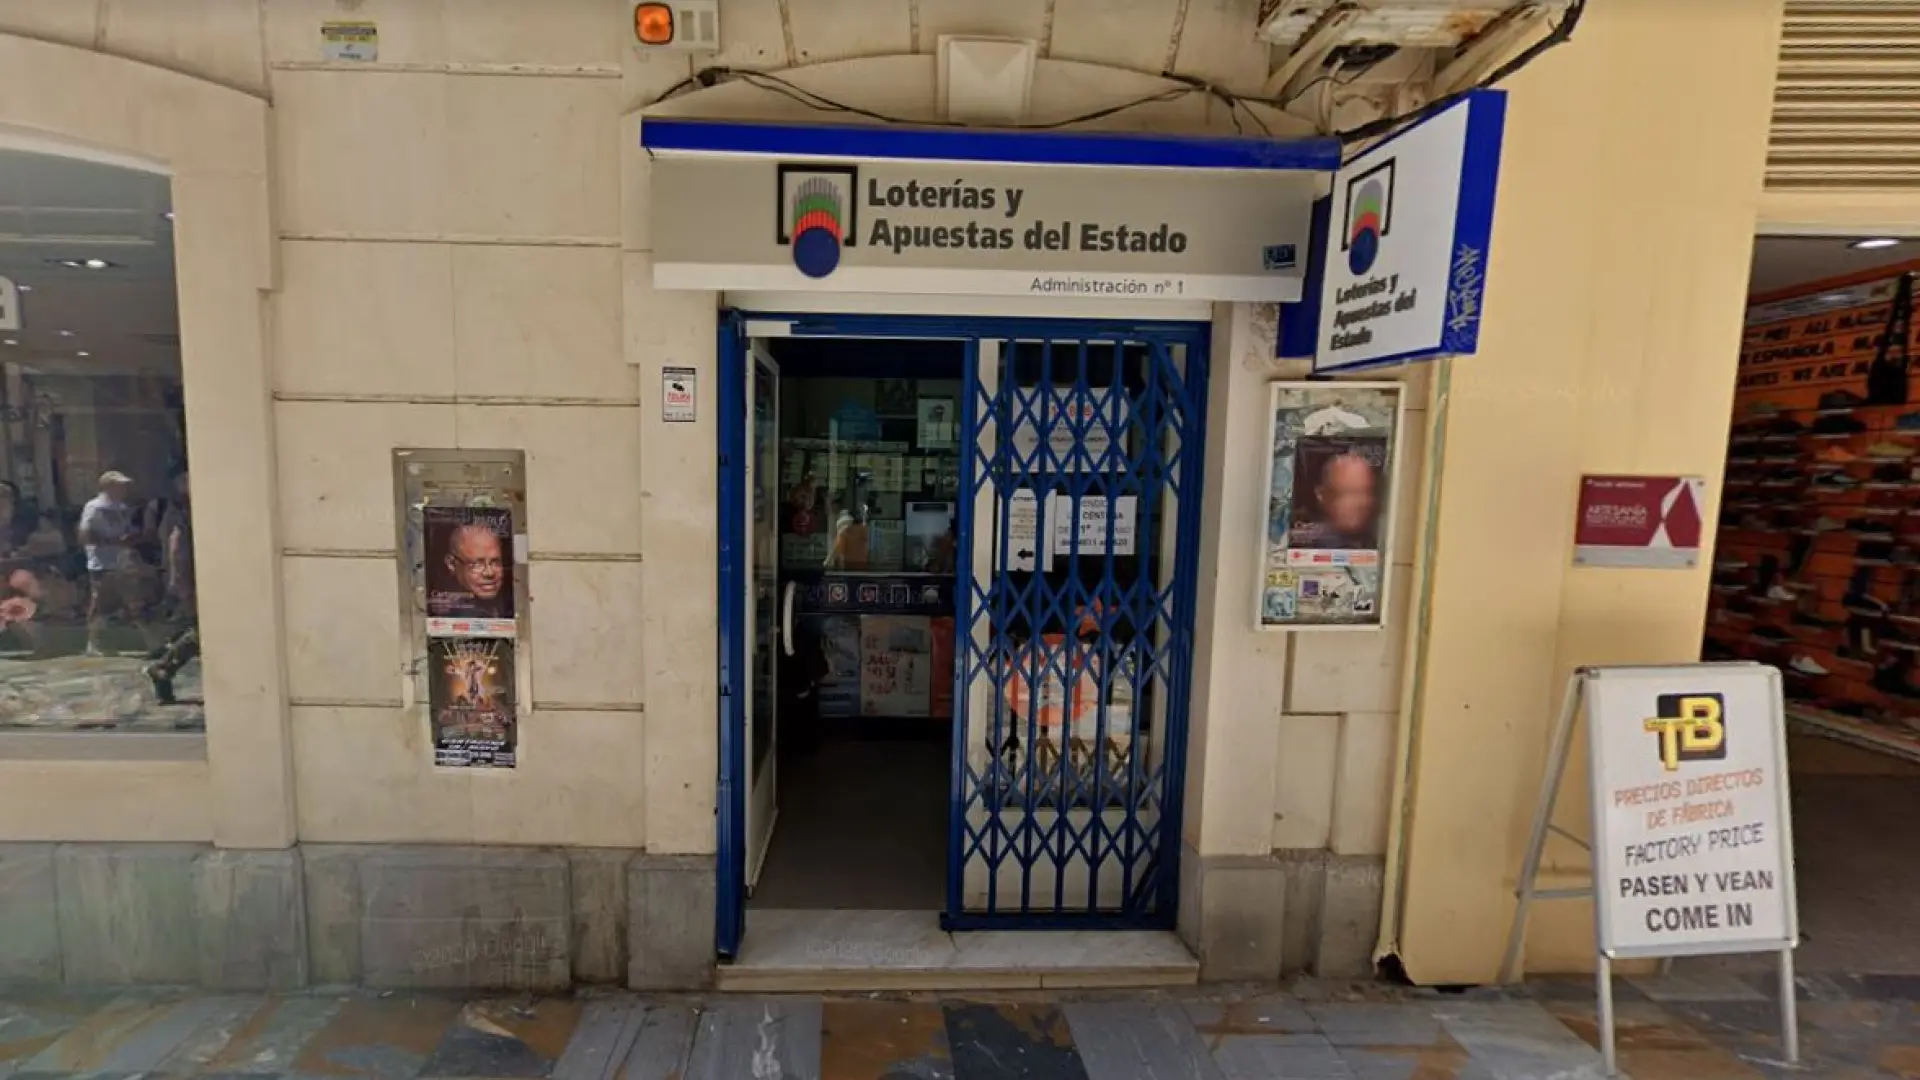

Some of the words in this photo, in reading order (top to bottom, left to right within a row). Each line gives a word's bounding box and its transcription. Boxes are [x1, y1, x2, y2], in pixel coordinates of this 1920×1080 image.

[868, 178, 996, 209] Loterías
[1004, 188, 1024, 218] y
[868, 217, 1014, 255] Apuestas
[1023, 219, 1071, 251] del
[1080, 222, 1188, 253] Estado
[1030, 275, 1148, 295] Administración
[1336, 276, 1387, 304] Loterías
[1389, 273, 1399, 296] y
[1333, 300, 1391, 330] Apuestas
[1394, 287, 1417, 312] del
[1330, 326, 1373, 350] Estado
[1614, 781, 1682, 808] PRECIOS
[1687, 768, 1764, 796] DIRECTOS
[1647, 809, 1667, 830] DE
[1625, 834, 1700, 867] FACTORY
[1708, 822, 1765, 850] PRICE
[1620, 875, 1688, 898] PASEN
[1695, 872, 1709, 892] Y
[1716, 870, 1774, 892] VEAN
[1646, 904, 1719, 932] COME
[1727, 902, 1753, 926] IN
